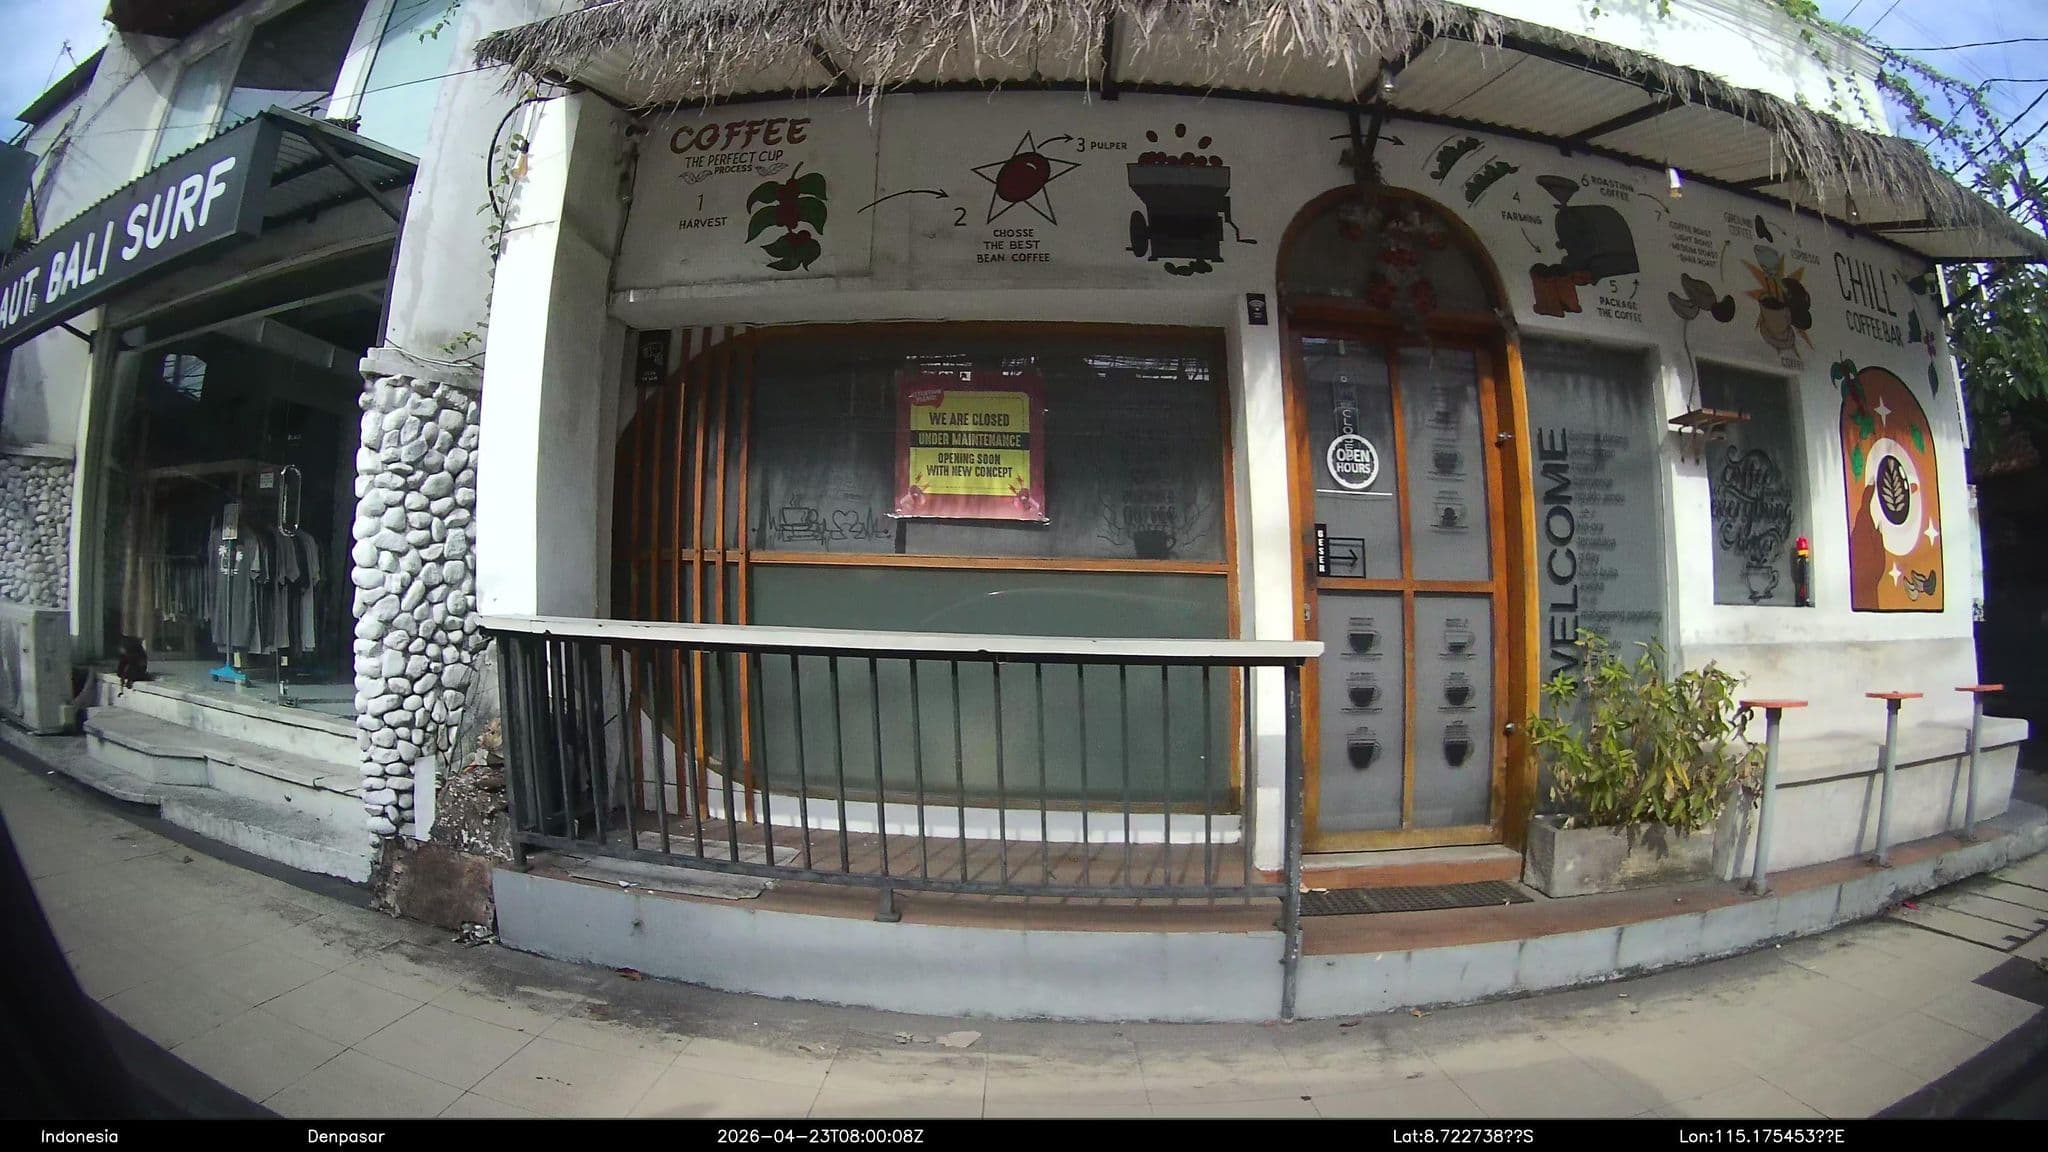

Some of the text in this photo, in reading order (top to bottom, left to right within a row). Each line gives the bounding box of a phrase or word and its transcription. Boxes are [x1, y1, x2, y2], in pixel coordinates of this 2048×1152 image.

[670, 117, 811, 154] COFFEE
[1077, 137, 1128, 152] 3 PULPER
[685, 150, 784, 168] THE PERFECT CUP
[714, 165, 753, 174] PROCESS
[1581, 174, 1590, 187] 6
[698, 194, 704, 211] 1
[1512, 191, 1521, 203] 4
[954, 206, 967, 226] 2
[1501, 211, 1543, 225] FARMING
[679, 217, 728, 230] HARVEST
[46, 220, 114, 304] BALI
[121, 157, 236, 261] SURF
[993, 229, 1034, 237] CHOSSE
[983, 240, 1040, 250] THE BEST
[977, 253, 1050, 263] BEAN COFFEE
[1610, 280, 1617, 293] 5
[1834, 252, 1897, 318] CHILL
[1599, 296, 1638, 310] PACKAGE
[1596, 307, 1612, 318] THE
[1846, 310, 1904, 348] COFFEE BAR
[929, 412, 1009, 426] WE ARE CLOSED
[919, 434, 1021, 447] UNDER MAINTENANCE
[938, 453, 1001, 465] OPENING SOON
[1336, 449, 1370, 462] OPEN
[927, 465, 1013, 478] WITH NEW CONCEPT
[1336, 462, 1371, 474] HOURS
